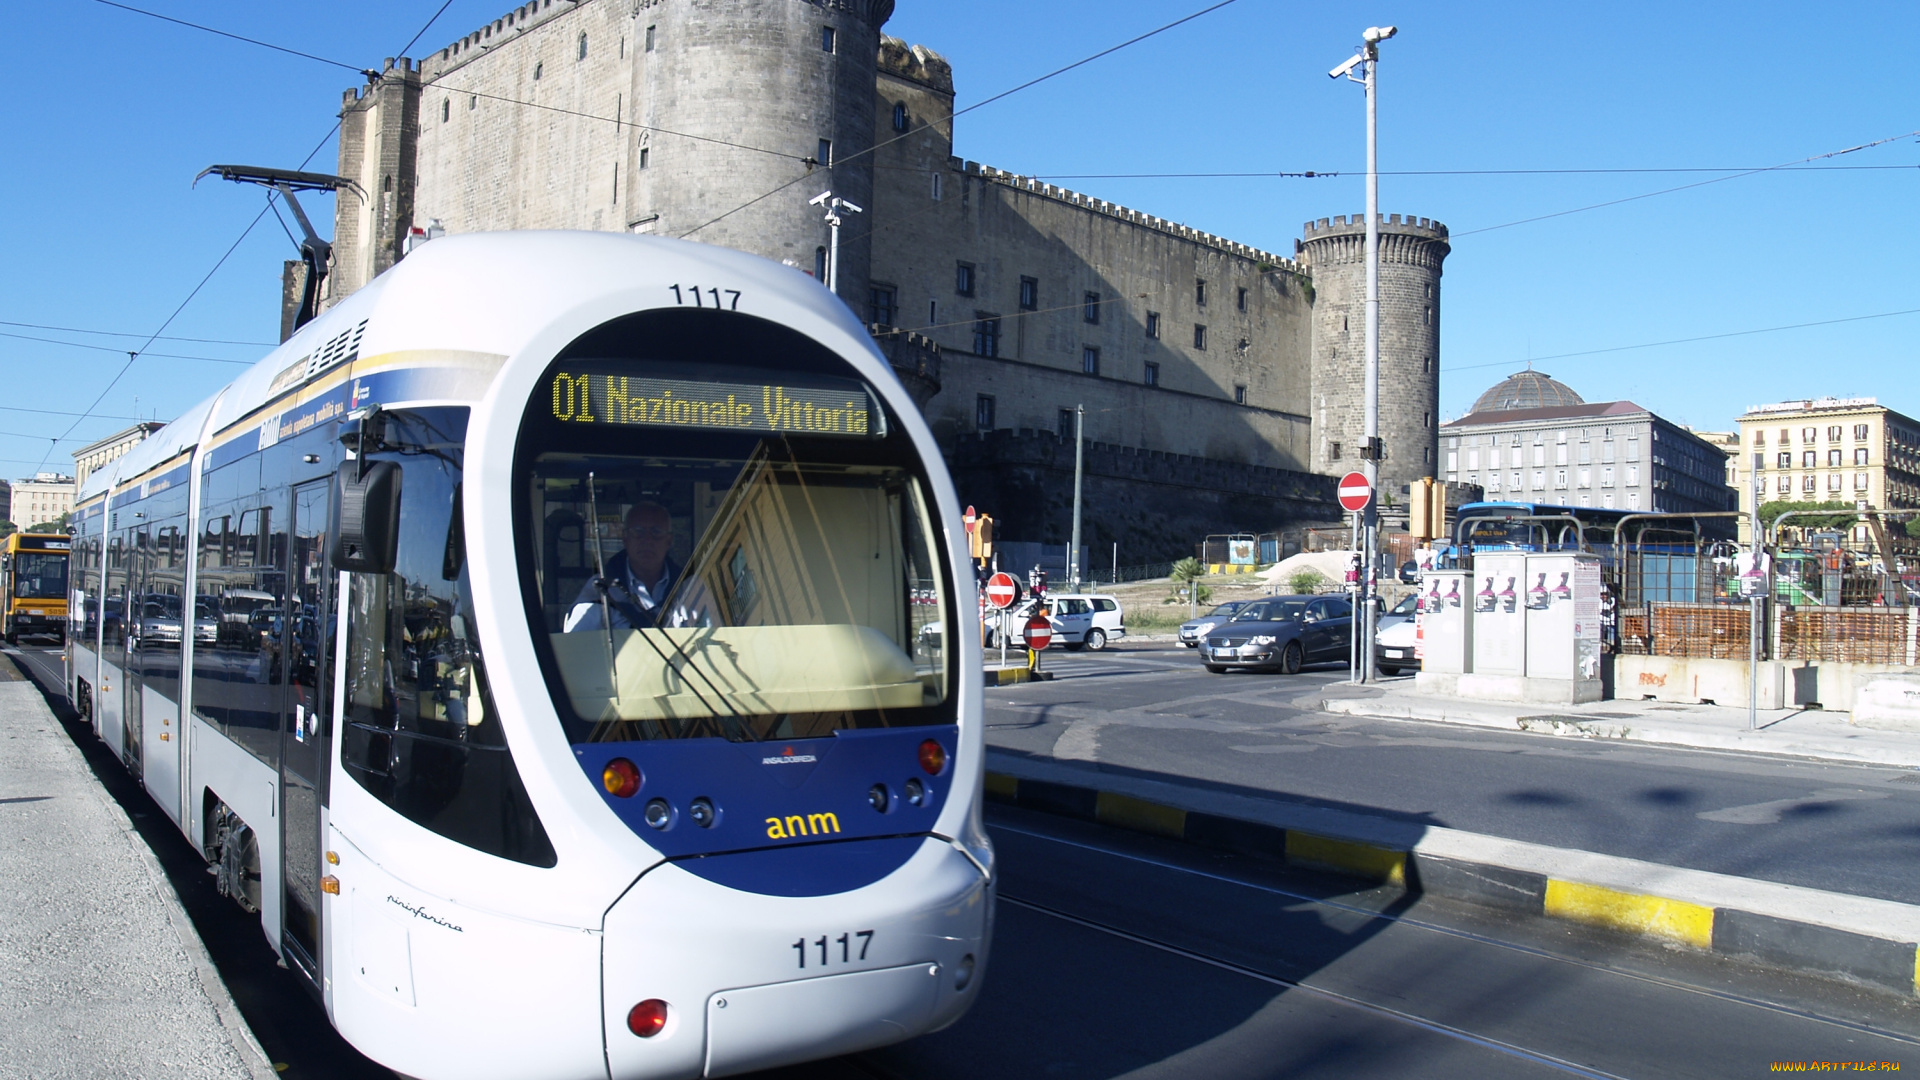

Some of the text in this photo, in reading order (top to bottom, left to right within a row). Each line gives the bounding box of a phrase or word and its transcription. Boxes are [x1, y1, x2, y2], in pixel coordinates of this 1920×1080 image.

[669, 283, 742, 311] 1117
[552, 372, 868, 433] 01 Nazionale Vittoria
[762, 755, 817, 765] ANSALDOBREDA
[765, 812, 841, 840] anm
[387, 894, 464, 932] pininfarina
[792, 929, 875, 969] 1117
